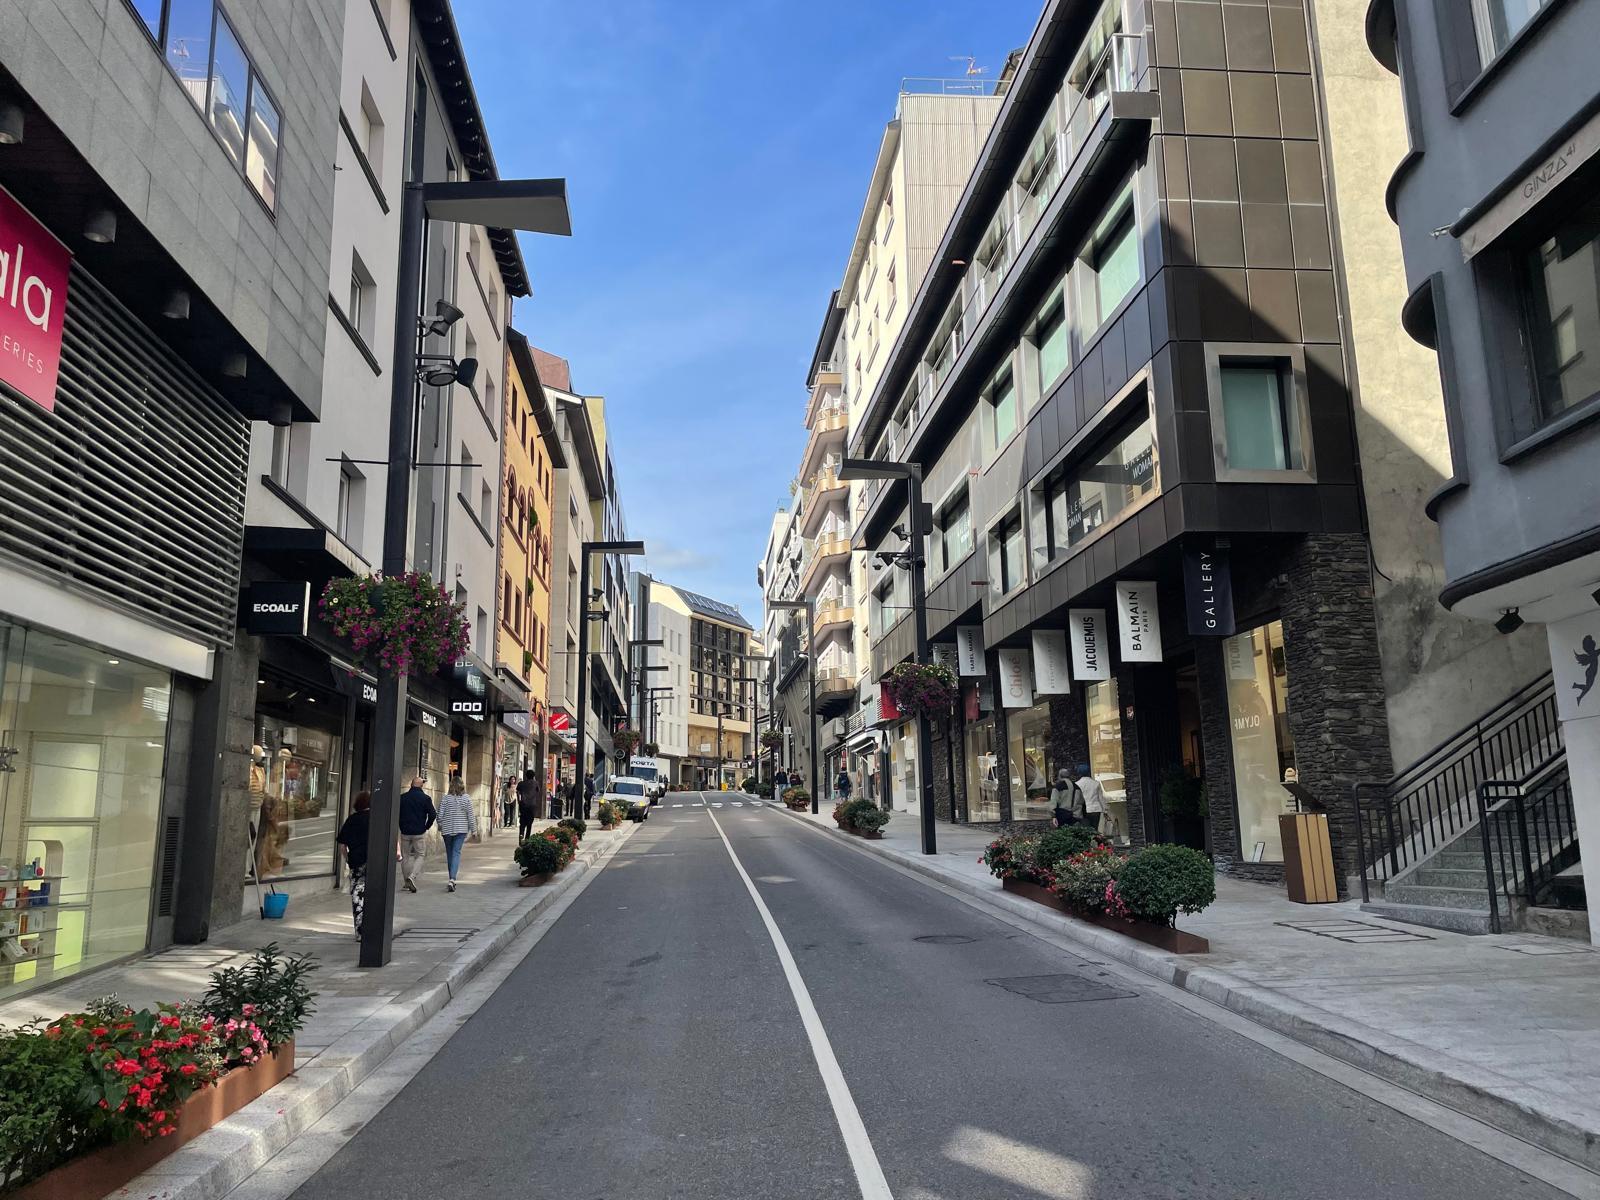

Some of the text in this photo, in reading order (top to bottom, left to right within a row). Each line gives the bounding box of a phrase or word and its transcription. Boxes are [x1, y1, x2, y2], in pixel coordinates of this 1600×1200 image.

[253, 603, 299, 613] ECOALF
[1201, 552, 1217, 628] GALLERY
[1083, 616, 1098, 672] JACQUEMUS
[1128, 591, 1142, 651] BALMAIN
[1009, 655, 1024, 699] Chloé
